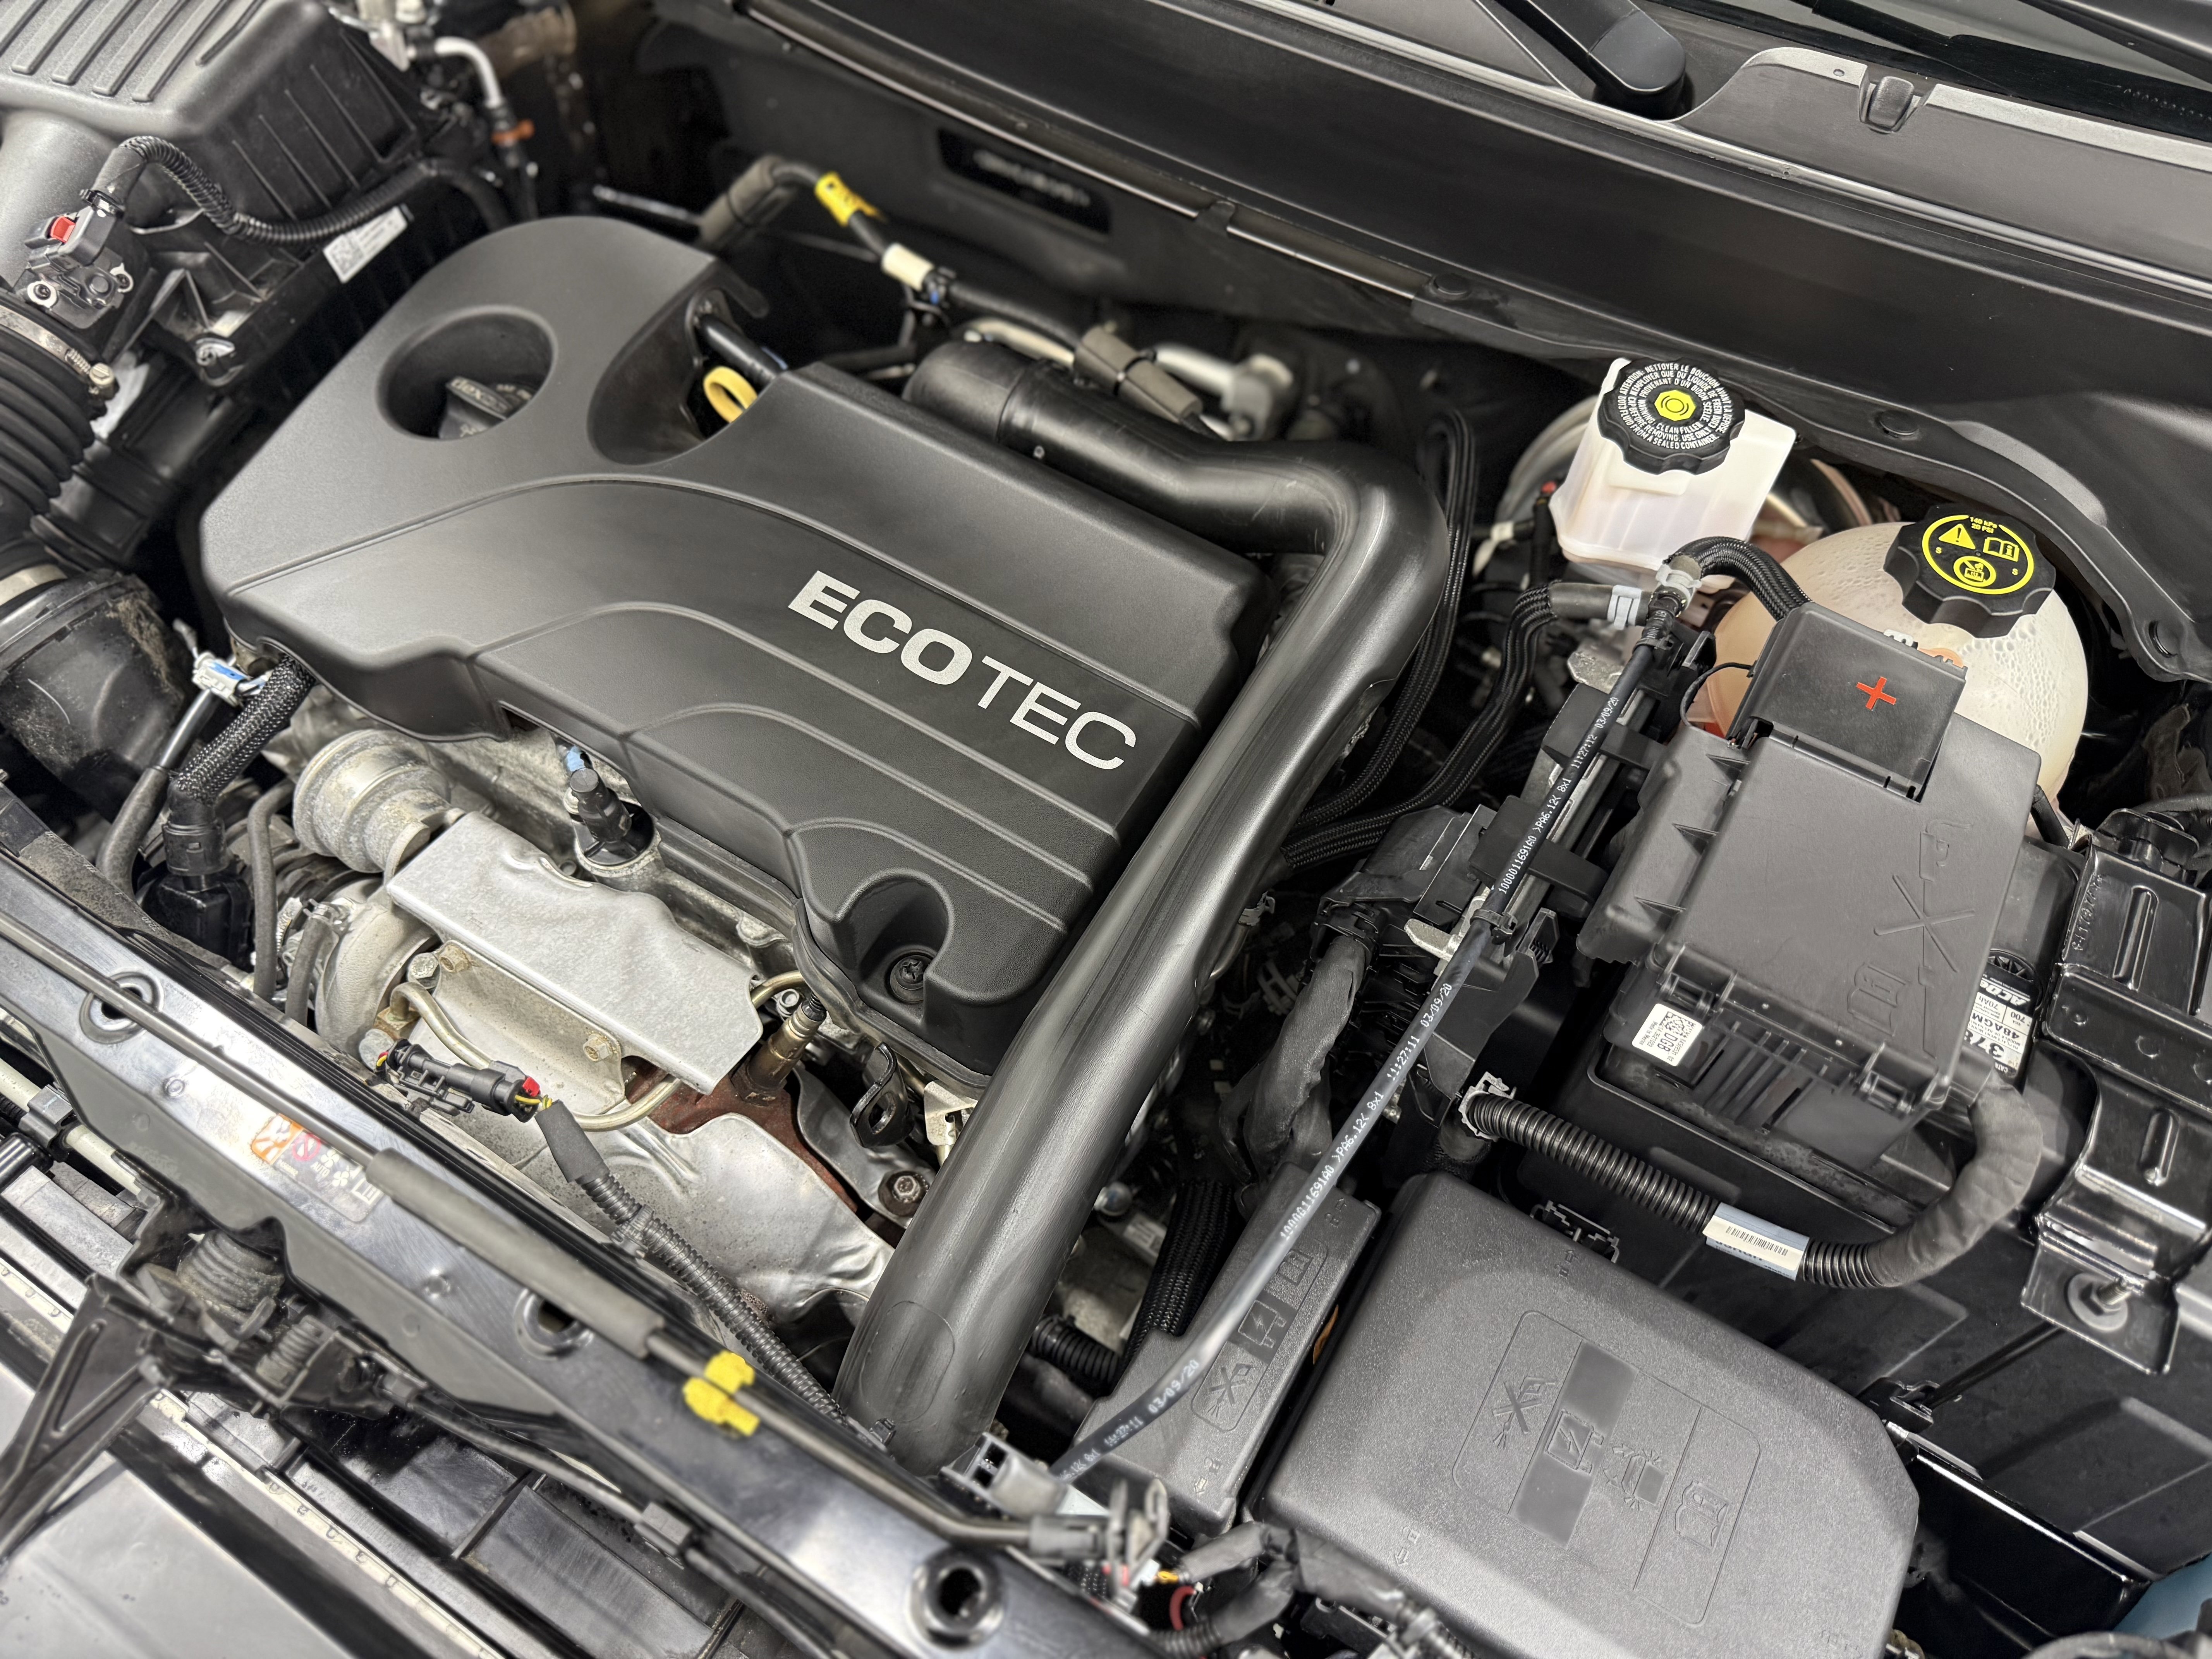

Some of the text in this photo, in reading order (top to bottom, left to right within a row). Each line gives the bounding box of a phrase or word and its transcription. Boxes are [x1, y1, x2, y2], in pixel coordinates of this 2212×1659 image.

[1639, 378, 1672, 398] PROVENANT
[1674, 378, 1692, 388] D'UN
[1691, 385, 1709, 401] BIDON
[1645, 362, 1679, 373] NETTOYER
[1691, 367, 1720, 388] BOUCHON
[1716, 386, 1731, 404] AVANT
[1724, 405, 1733, 413] LA
[1688, 374, 1712, 392] LIQUIDE
[1618, 395, 1626, 410] DOT3
[1708, 390, 1717, 398] DE
[1712, 398, 1723, 414] FREIN
[1620, 410, 1634, 426] FLUID
[1628, 397, 1712, 442] CAP BEFORE REMOVING. USE ONLY
[1708, 414, 1722, 429] DOT3
[1630, 423, 1649, 440] FROM
[1656, 422, 1679, 434] CLEAN
[1680, 421, 1704, 434] FILLER
[1652, 438, 1680, 449] SEALED
[1680, 433, 1719, 450] CONTAINER.
[1982, 526, 1994, 534] PSI
[1984, 520, 1997, 529] kPa
[787, 570, 1137, 771] ECOTEC
[1556, 777, 1571, 793] 8x1
[1570, 734, 1598, 769] 11:27:12
[1594, 696, 1619, 729] 03/09/20
[1972, 1012, 2020, 1039] 48AGM
[2010, 1011, 2025, 1023] 700
[1367, 1090, 1385, 1111] 8x1
[1386, 1035, 1421, 1082] 11:27:11
[1420, 982, 1453, 1029] 03/09/20
[1657, 1032, 1678, 1052] DGB
[310, 1161, 330, 1177] AUTO
[1147, 1359, 1199, 1413] 03/09/20
